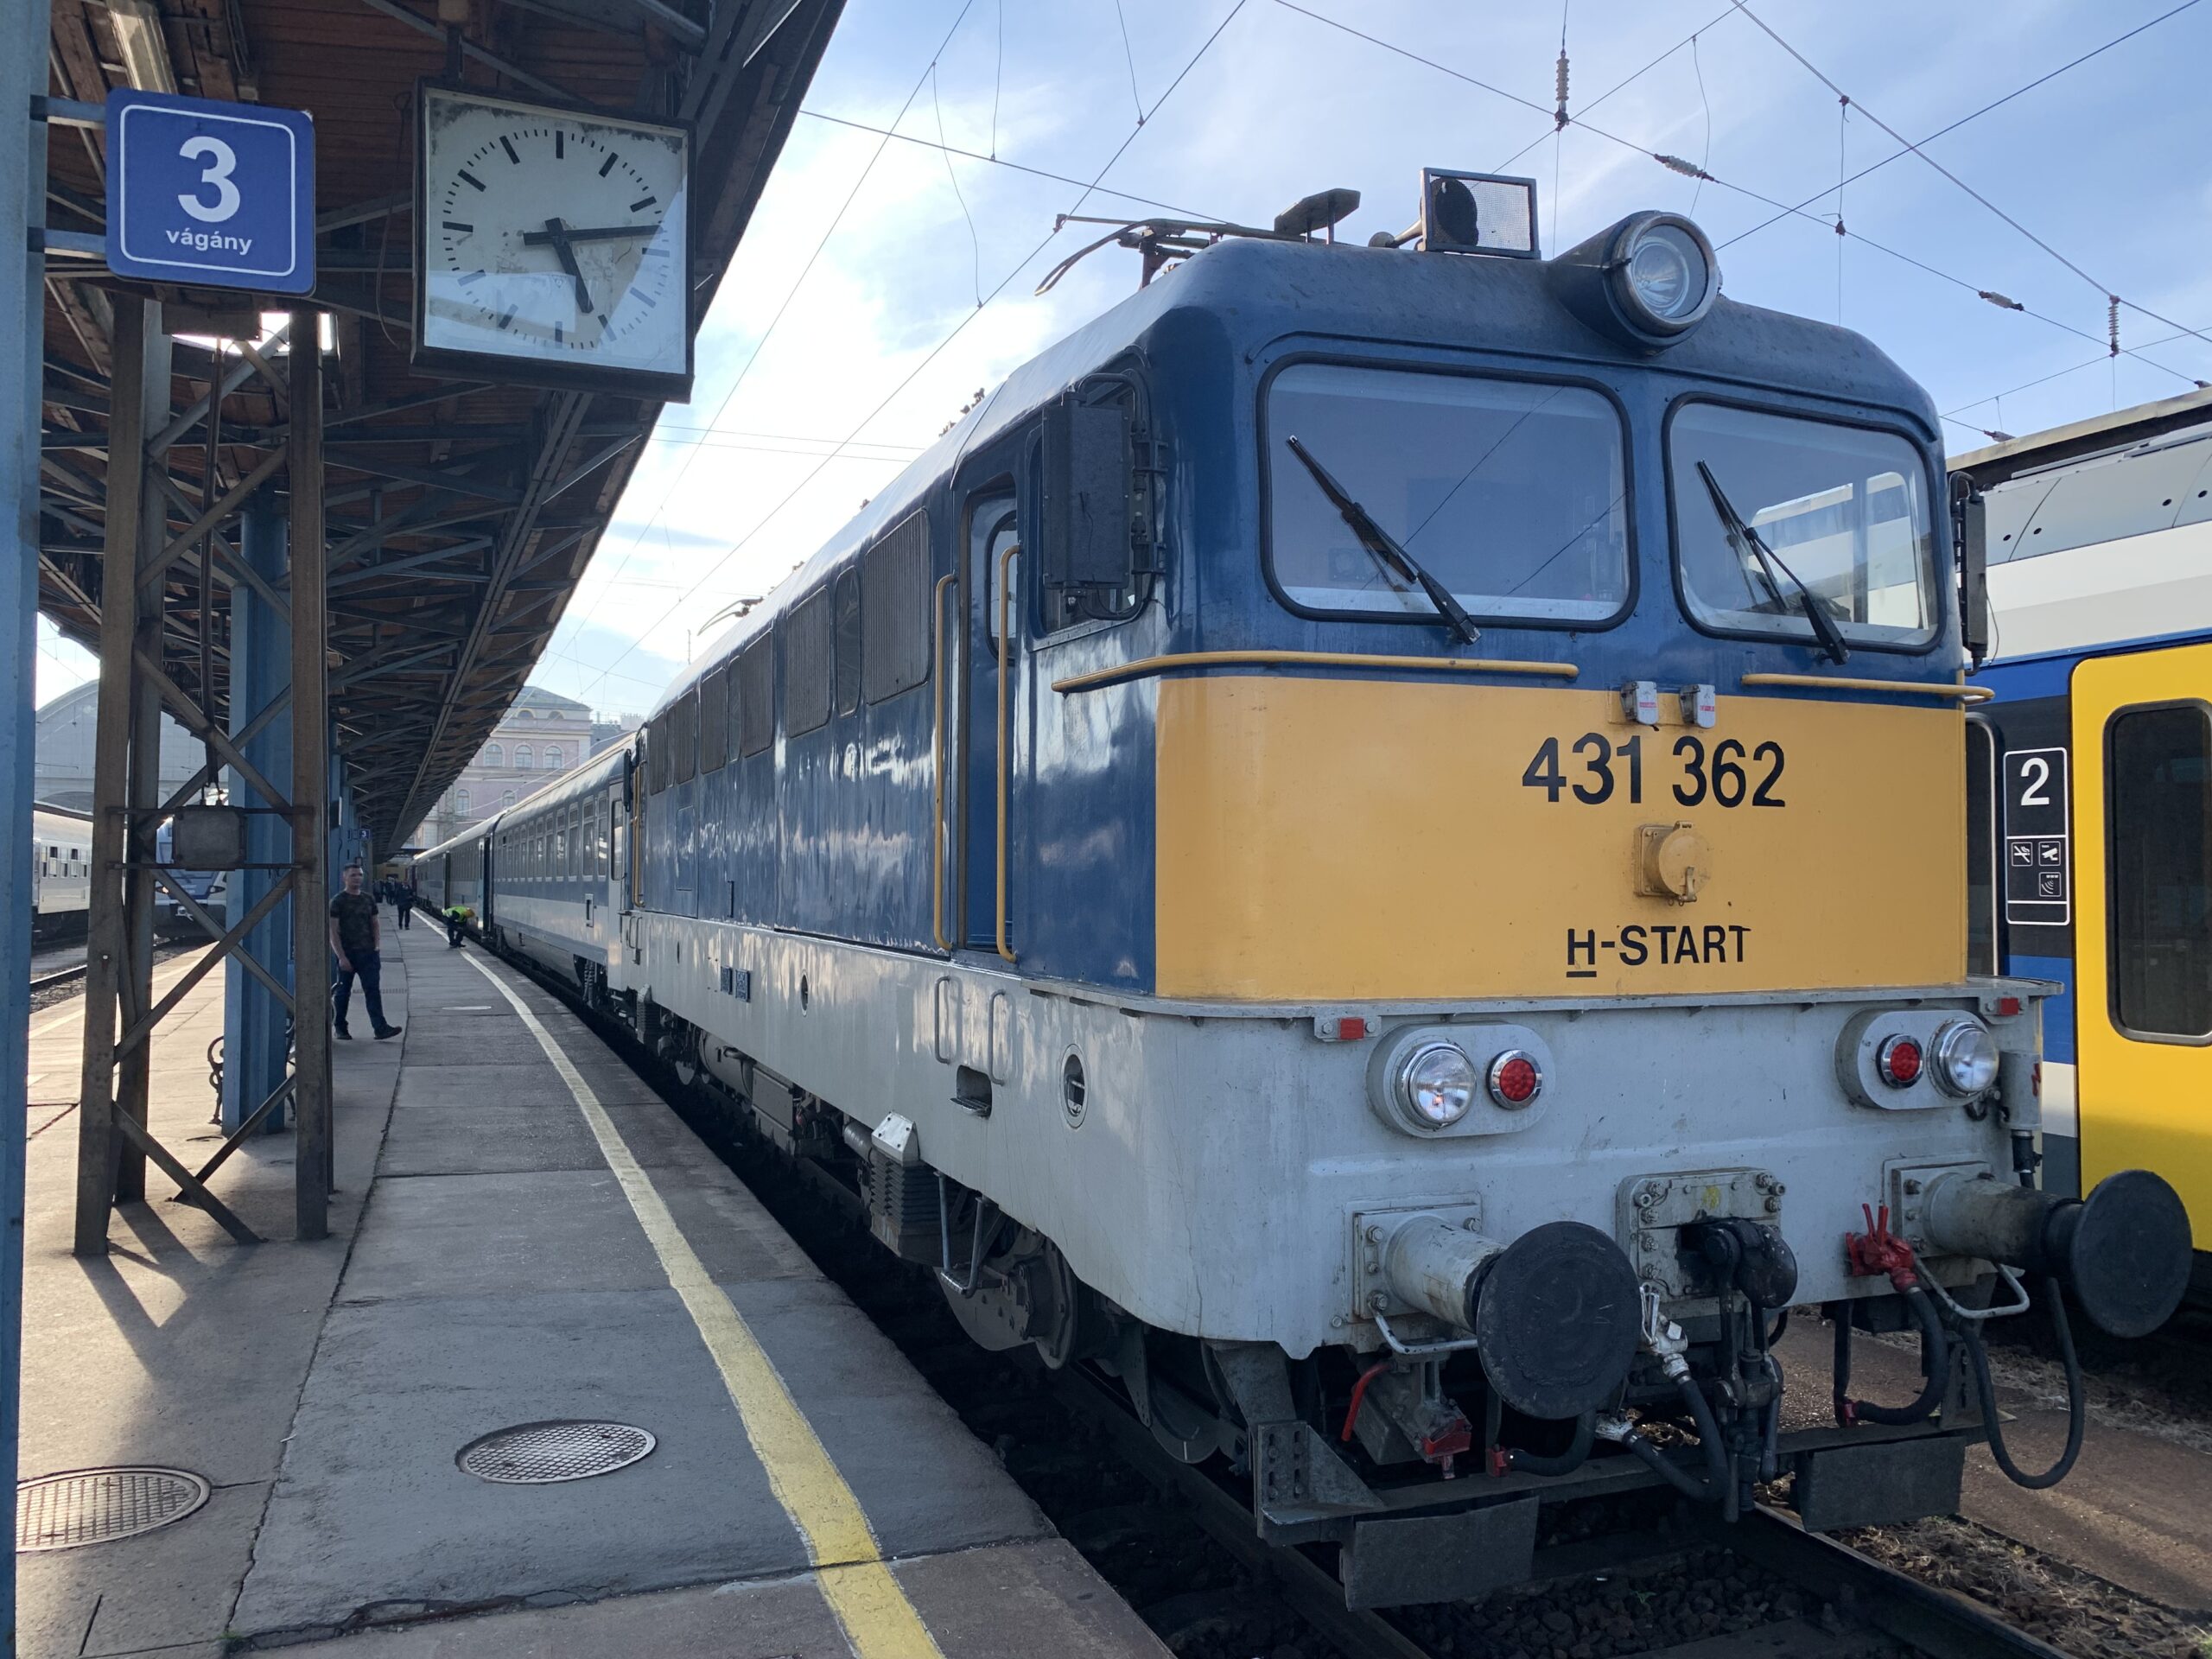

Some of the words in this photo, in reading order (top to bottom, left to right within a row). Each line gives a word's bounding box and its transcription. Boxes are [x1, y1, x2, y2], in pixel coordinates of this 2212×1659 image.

[178, 136, 240, 222] 3
[166, 228, 252, 256] vágány
[1522, 733, 1641, 804] 431
[1672, 735, 1785, 808] 362
[2020, 757, 2050, 805] 2
[1567, 925, 1751, 977] H-START
